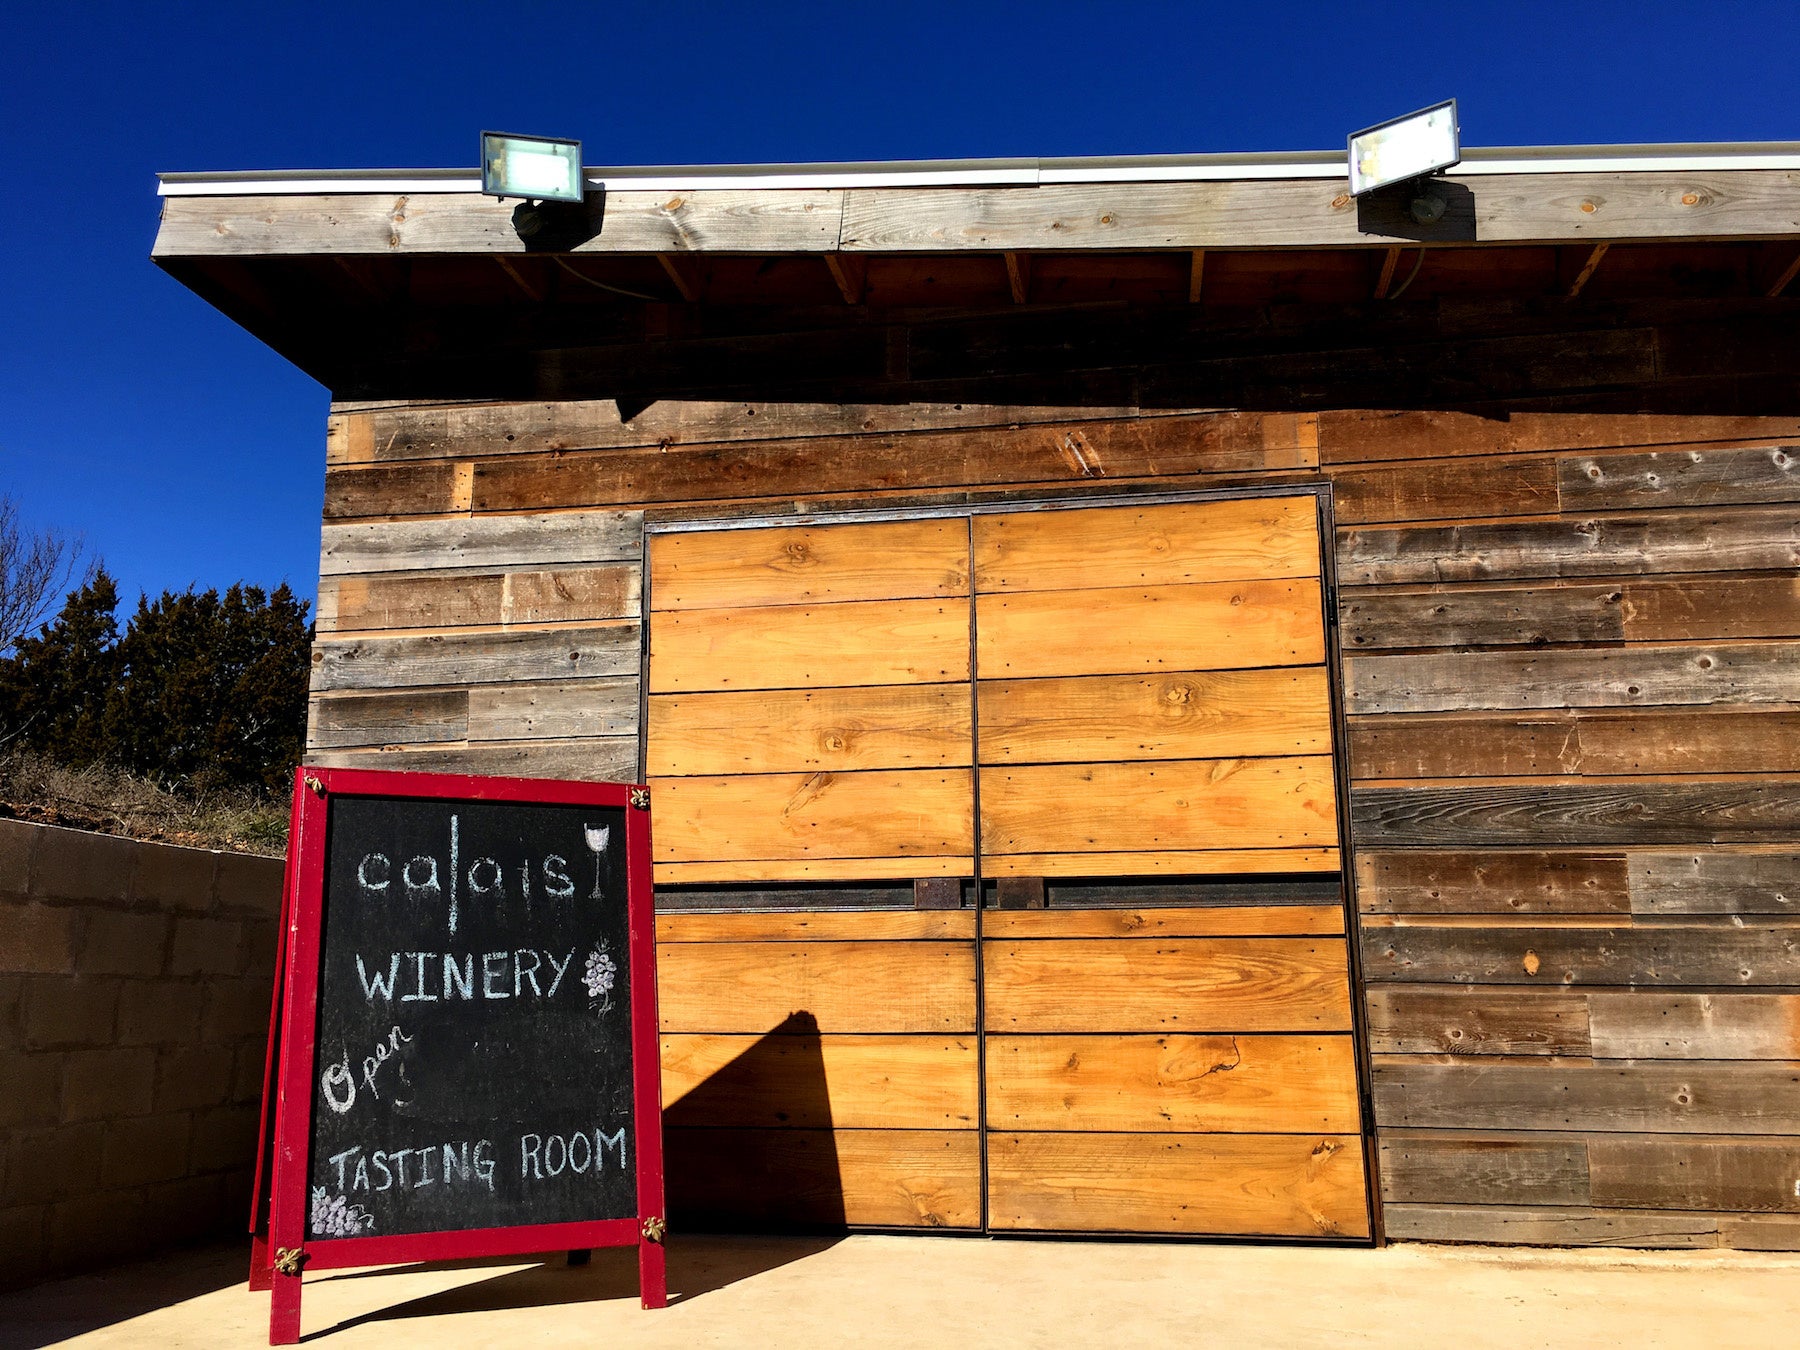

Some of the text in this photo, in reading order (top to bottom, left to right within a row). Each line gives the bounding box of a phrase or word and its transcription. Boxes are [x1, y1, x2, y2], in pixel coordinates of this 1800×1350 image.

[357, 814, 576, 936] calais
[356, 946, 576, 1001] WINERY
[321, 1025, 414, 1114] Open
[329, 1127, 626, 1192] TASTING ROOM
